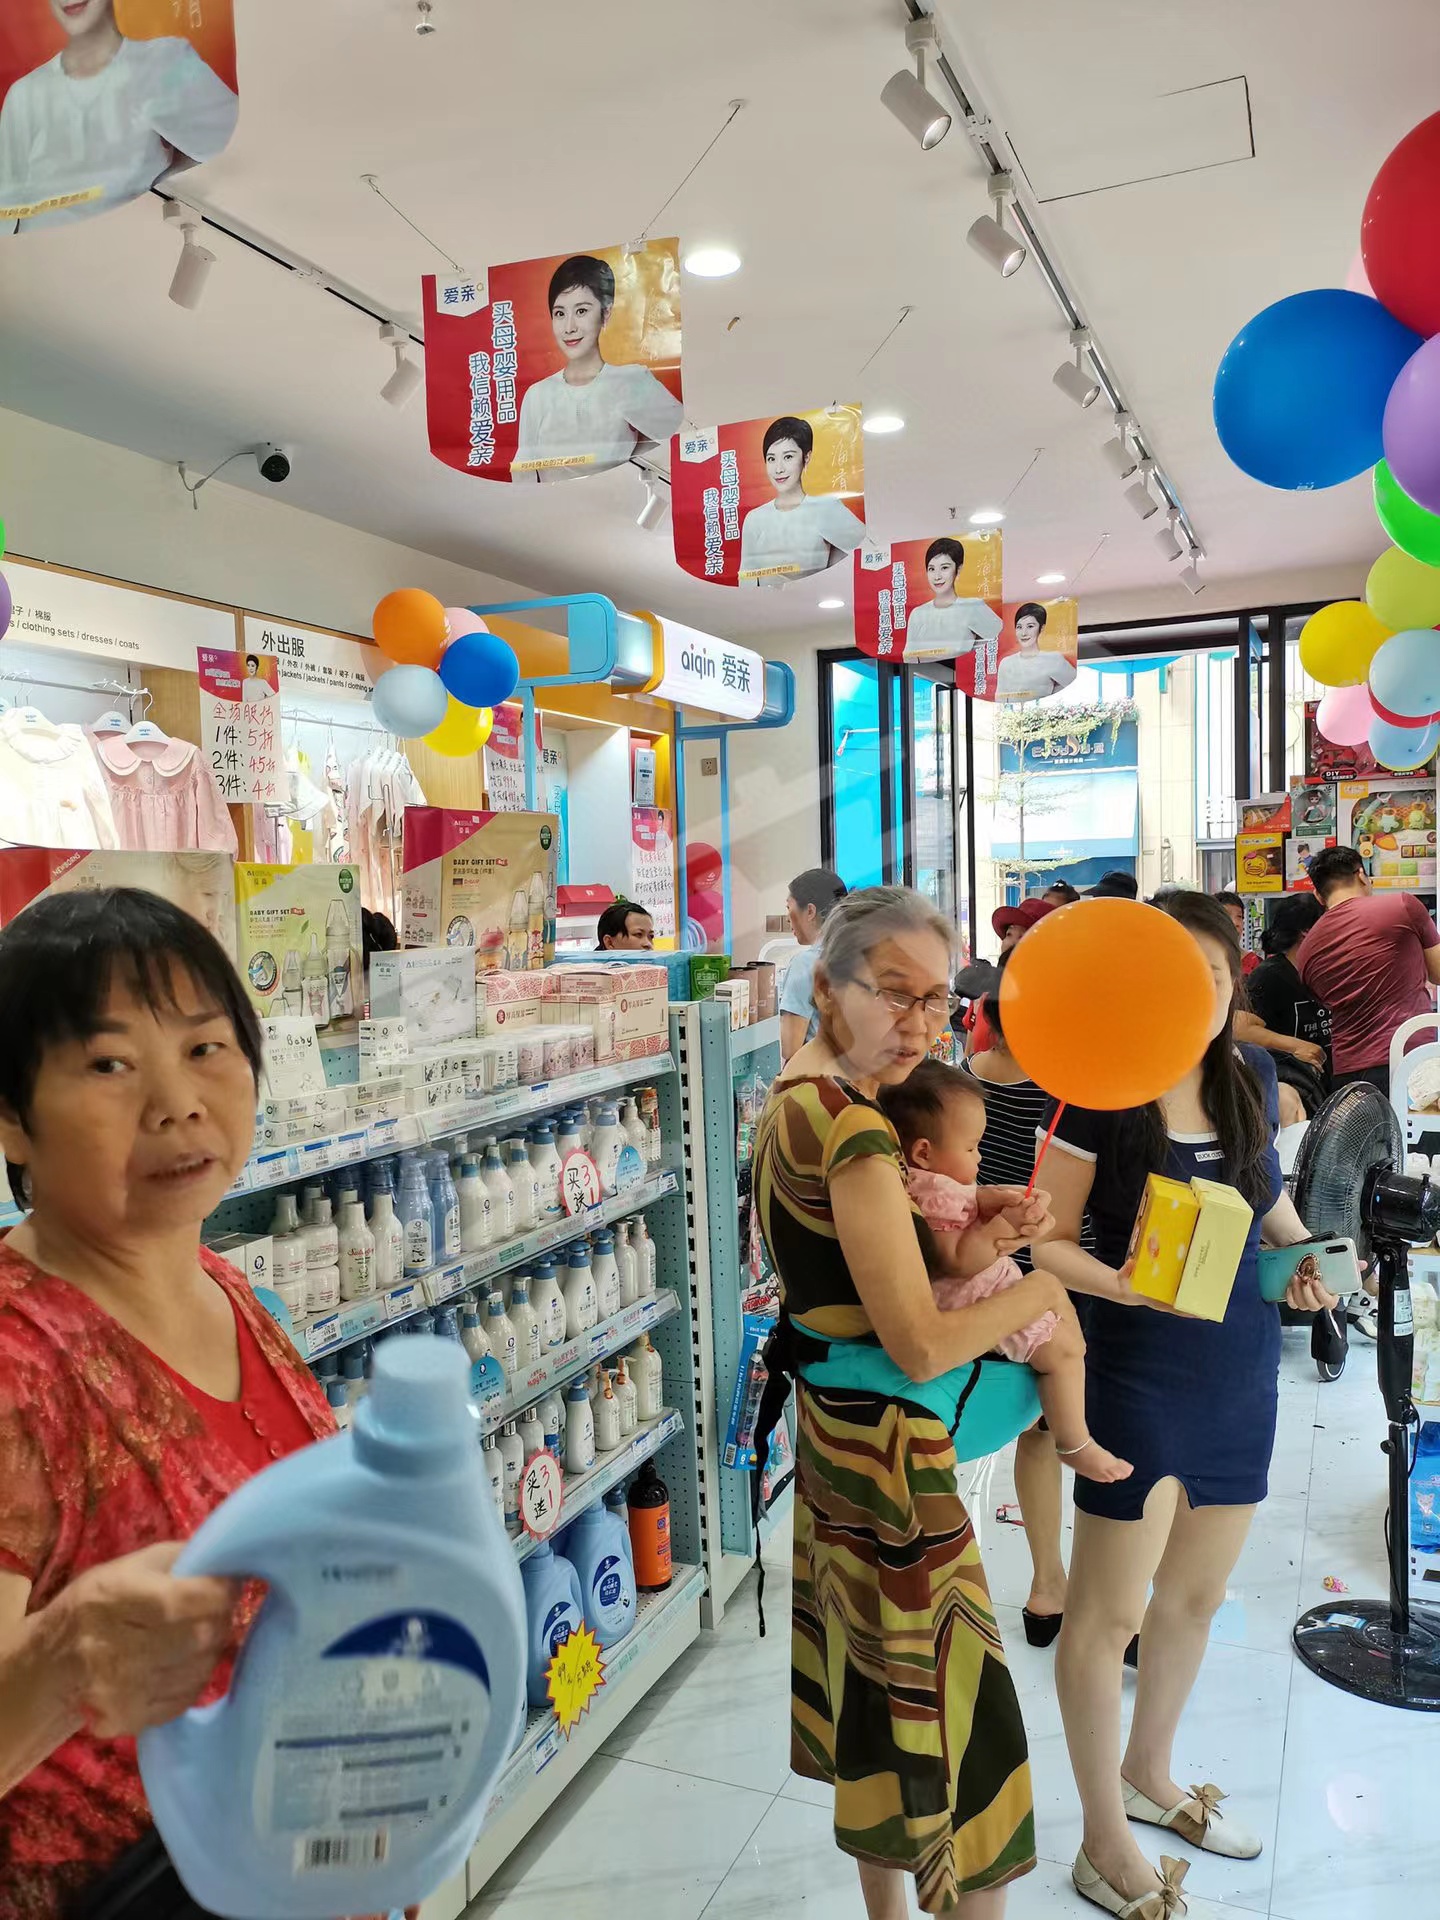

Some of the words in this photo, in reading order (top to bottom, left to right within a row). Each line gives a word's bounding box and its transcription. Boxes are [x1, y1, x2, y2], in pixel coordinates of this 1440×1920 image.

[443, 284, 475, 304] 爱亲
[492, 301, 516, 423] 买母婴用品
[468, 352, 495, 467] 我信赖爱亲
[685, 439, 708, 454] 爱亲
[720, 450, 740, 539] 买母婴用品
[703, 488, 724, 576] 我信赖爱亲
[892, 561, 907, 629] 买母婴用品
[22, 622, 56, 636] clothing
[57, 628, 75, 638] sets
[81, 632, 113, 645] dresses
[119, 640, 140, 650] coats
[878, 589, 894, 654] 我信赖爱亲
[261, 630, 305, 658] 外出服
[281, 669, 302, 680] jackets
[306, 673, 325, 684] jackets
[329, 679, 344, 688] pants
[348, 682, 367, 692] clothing
[681, 643, 715, 680] aiqin
[722, 653, 750, 693] 爱亲
[286, 1033, 313, 1047] Baby
[1303, 1018, 1333, 1033] THIGS
